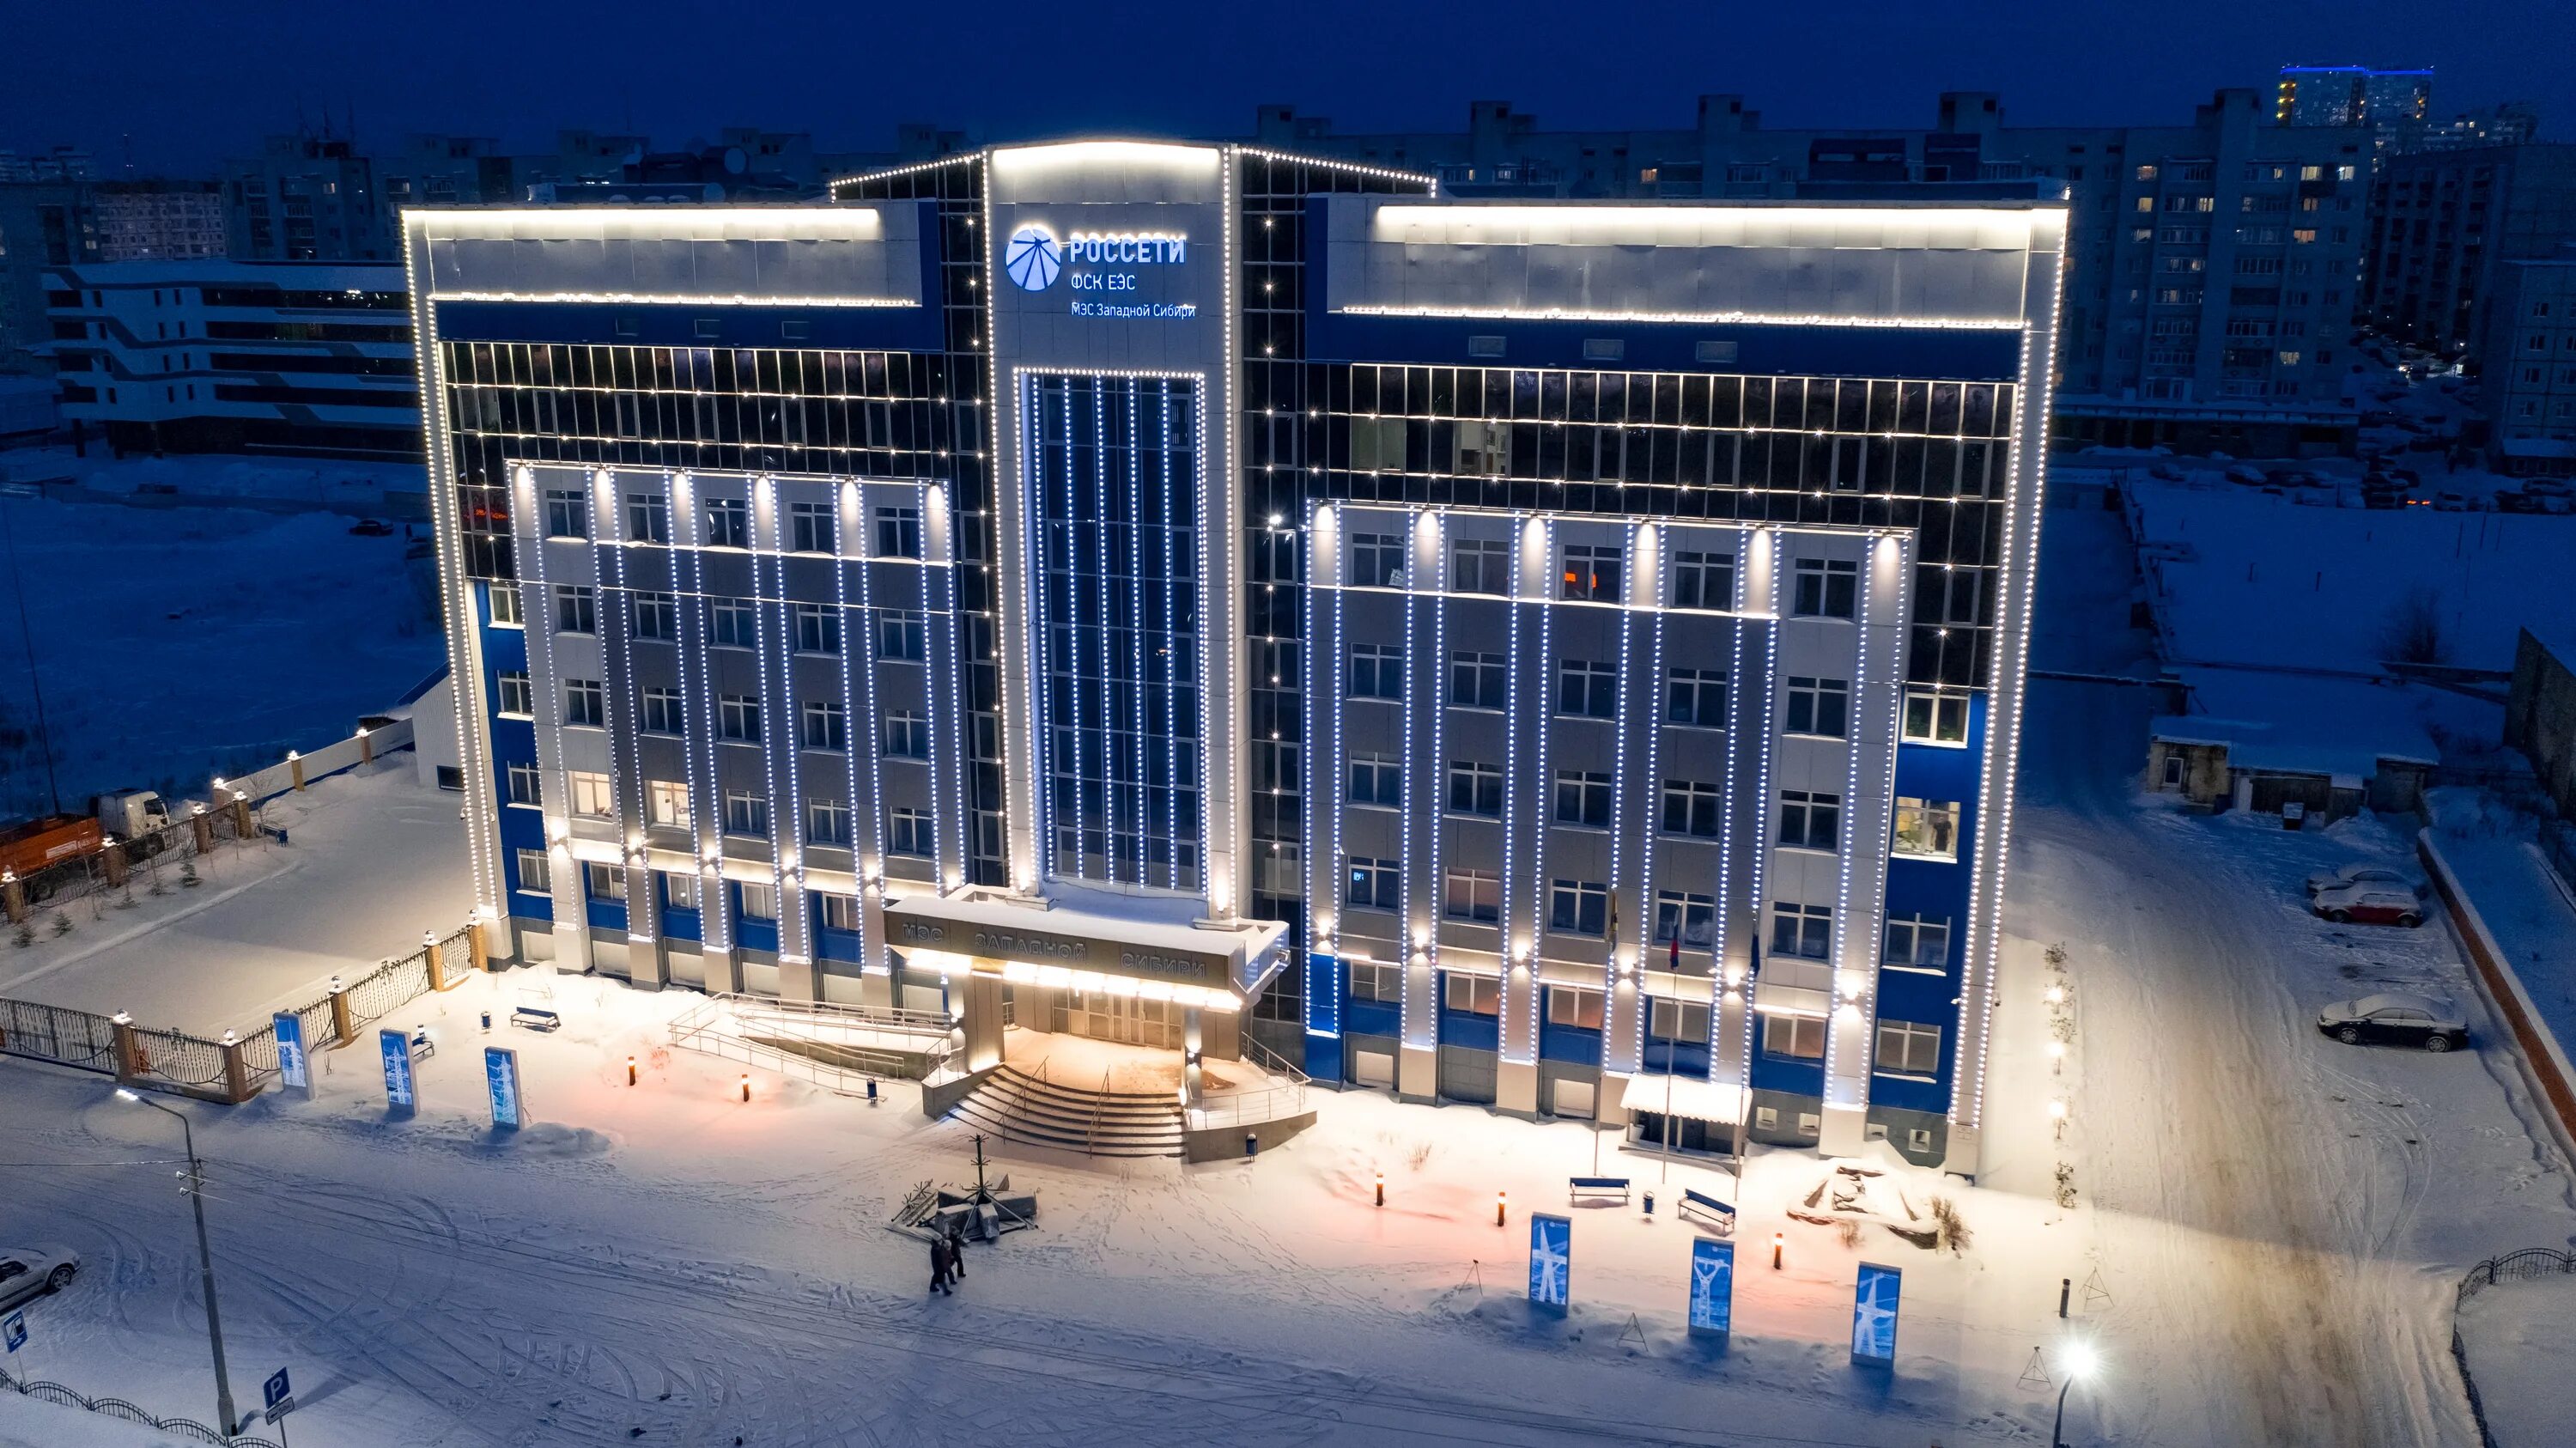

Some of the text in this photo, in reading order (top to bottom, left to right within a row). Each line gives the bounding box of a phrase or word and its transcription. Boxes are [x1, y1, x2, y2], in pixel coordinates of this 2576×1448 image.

[1070, 238, 1185, 263] РОССЕТИ
[1071, 273, 1135, 289] ФСК ЕЭС
[1072, 302, 1196, 319] МЭС Западной Сибири
[902, 923, 1206, 979] МЭС ЗАПАДНОЙ СИБИРИ
[270, 1377, 283, 1402] P
